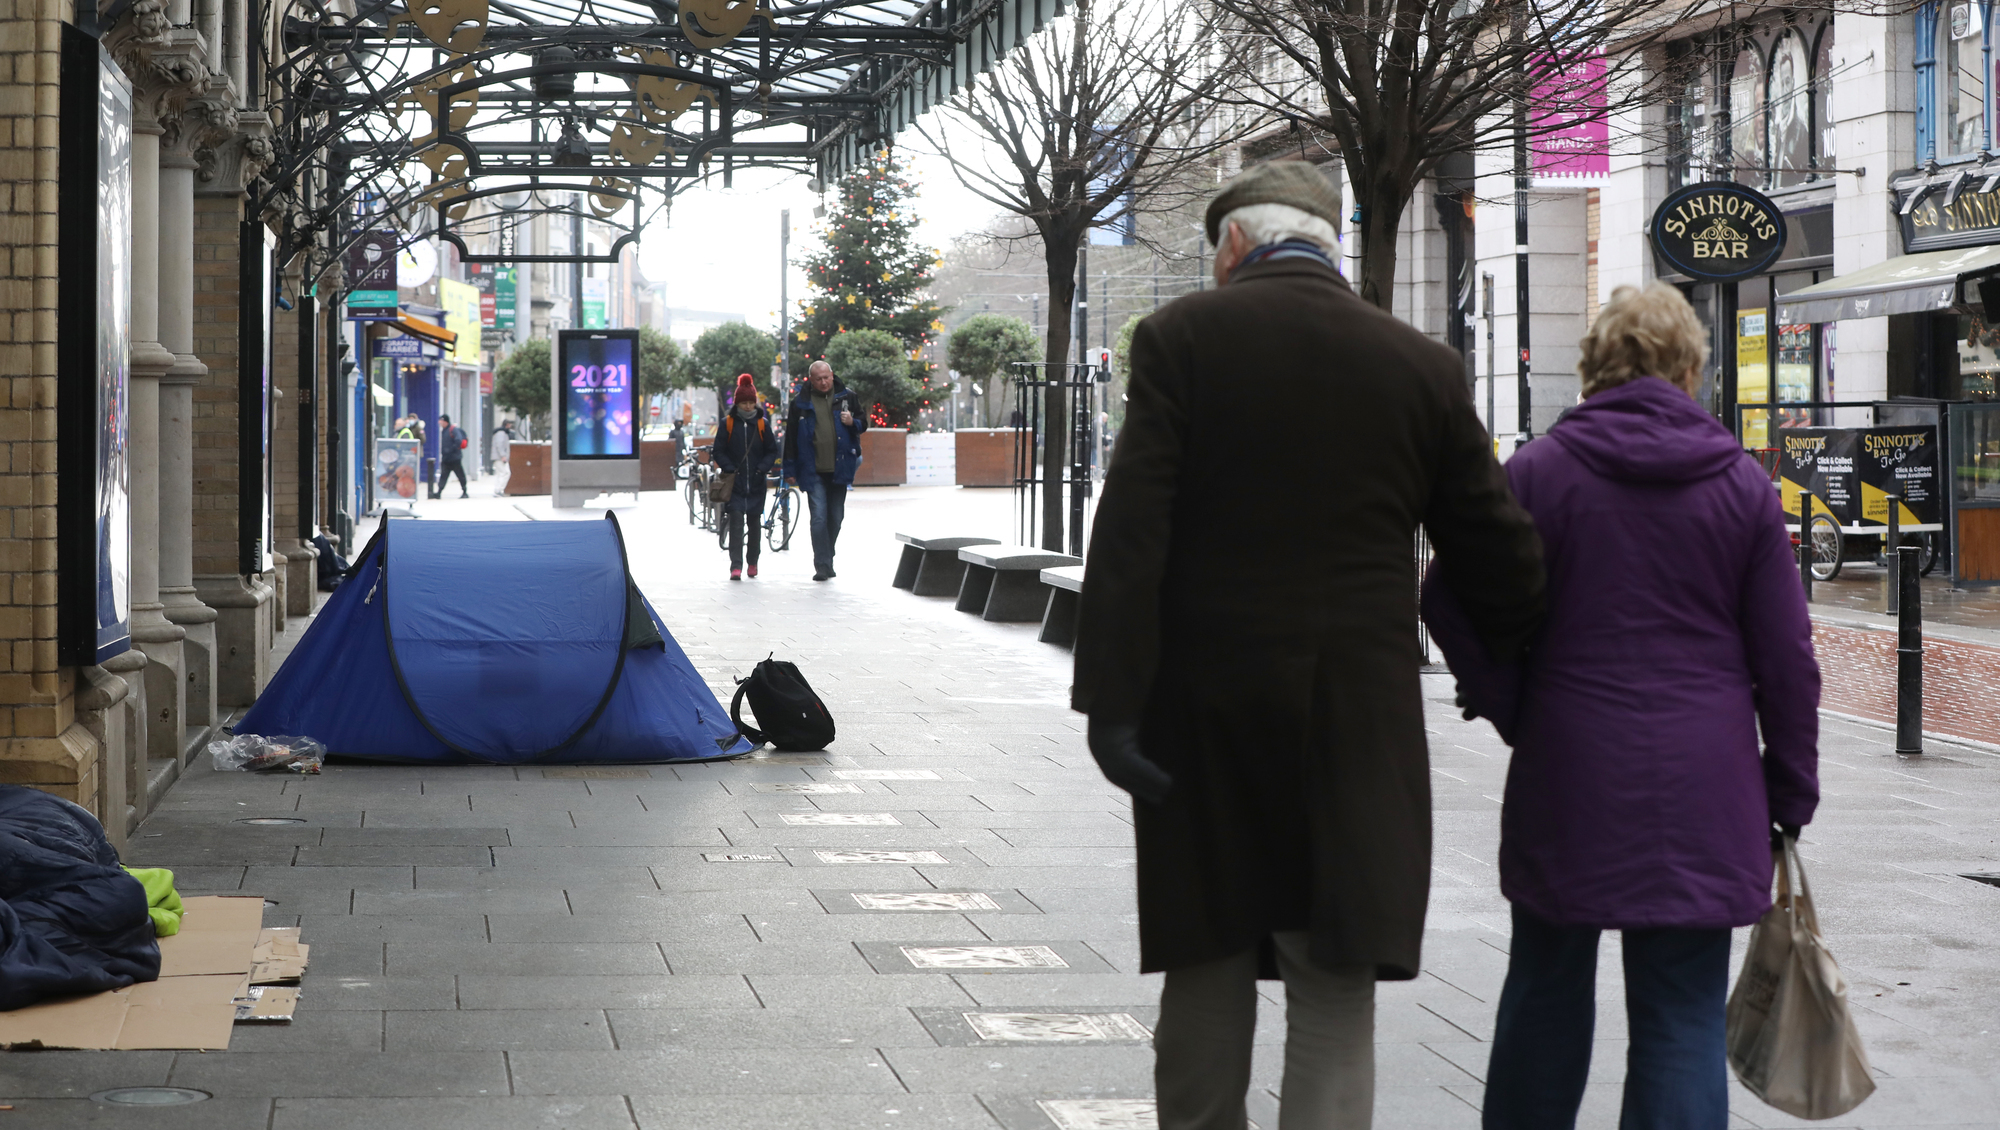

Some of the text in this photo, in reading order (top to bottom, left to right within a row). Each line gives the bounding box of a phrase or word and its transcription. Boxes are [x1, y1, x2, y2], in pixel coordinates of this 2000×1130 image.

[1544, 135, 1594, 150] HANDS
[1944, 188, 2000, 231] SINNO
[1664, 195, 1777, 240] SINNOTTS
[502, 215, 514, 269] TOPSHP
[1692, 241, 1749, 258] BAR
[471, 276, 490, 288] Sale
[571, 364, 627, 387] 2021
[1791, 450, 1802, 459] BAR
[1816, 456, 1829, 465] Click
[1834, 456, 1853, 465] Collect
[1873, 448, 1889, 458] BAR
[1817, 465, 1853, 473] Now Available
